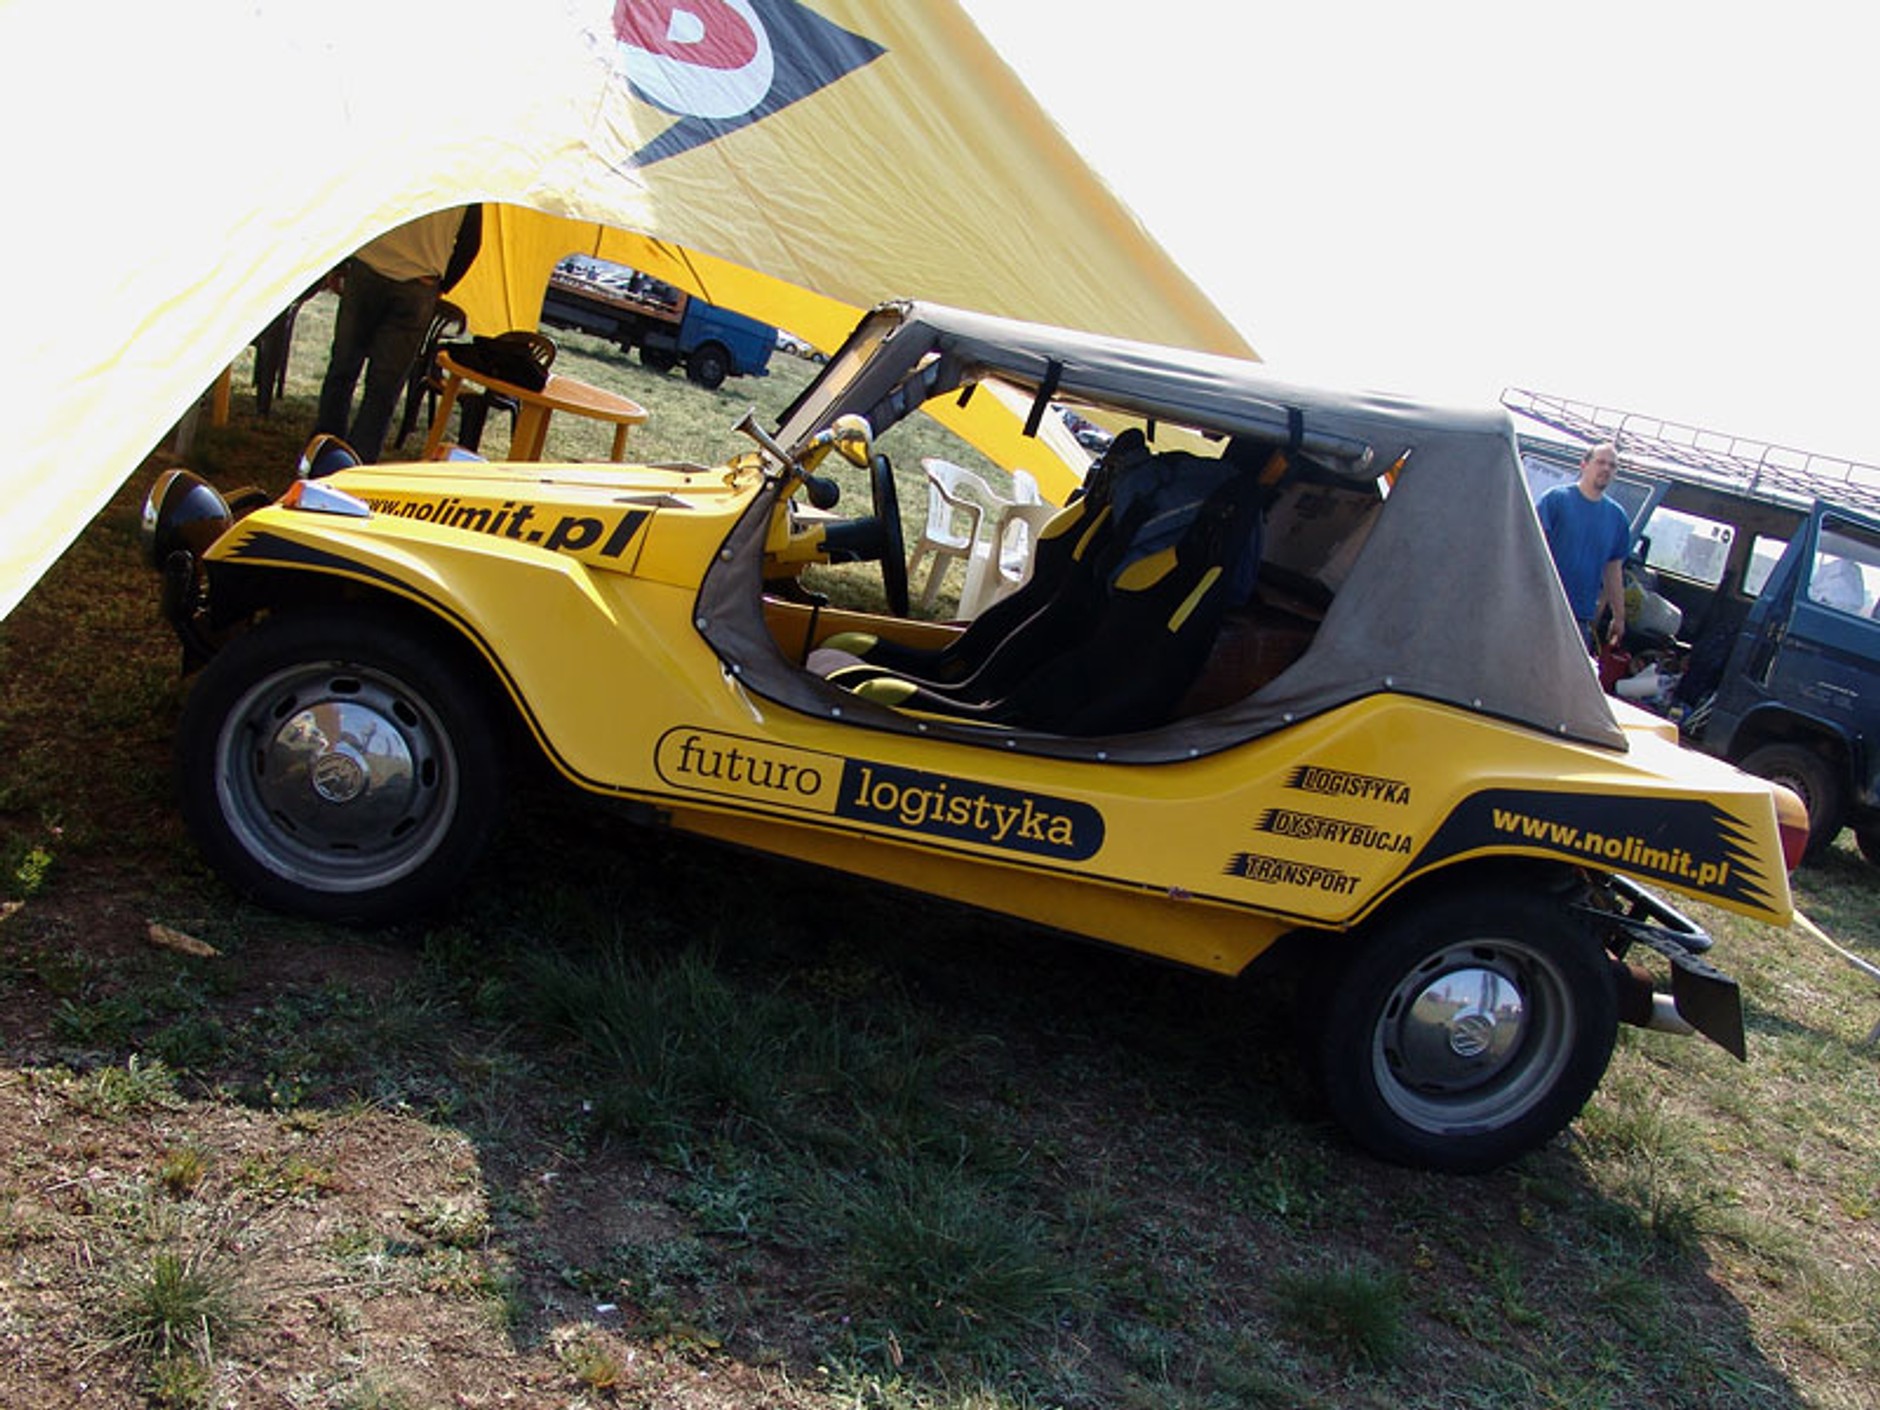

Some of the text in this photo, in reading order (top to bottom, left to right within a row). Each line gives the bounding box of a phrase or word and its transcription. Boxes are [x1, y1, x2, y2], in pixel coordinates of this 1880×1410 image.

[676, 737, 1074, 846] futuro logistyka
[1304, 767, 1411, 805] LOGISTYKA
[1275, 811, 1413, 854] DYSTRYBUCJA
[1492, 808, 1730, 885] www.nolimit.pl
[1247, 856, 1361, 895] TRANSPORT
